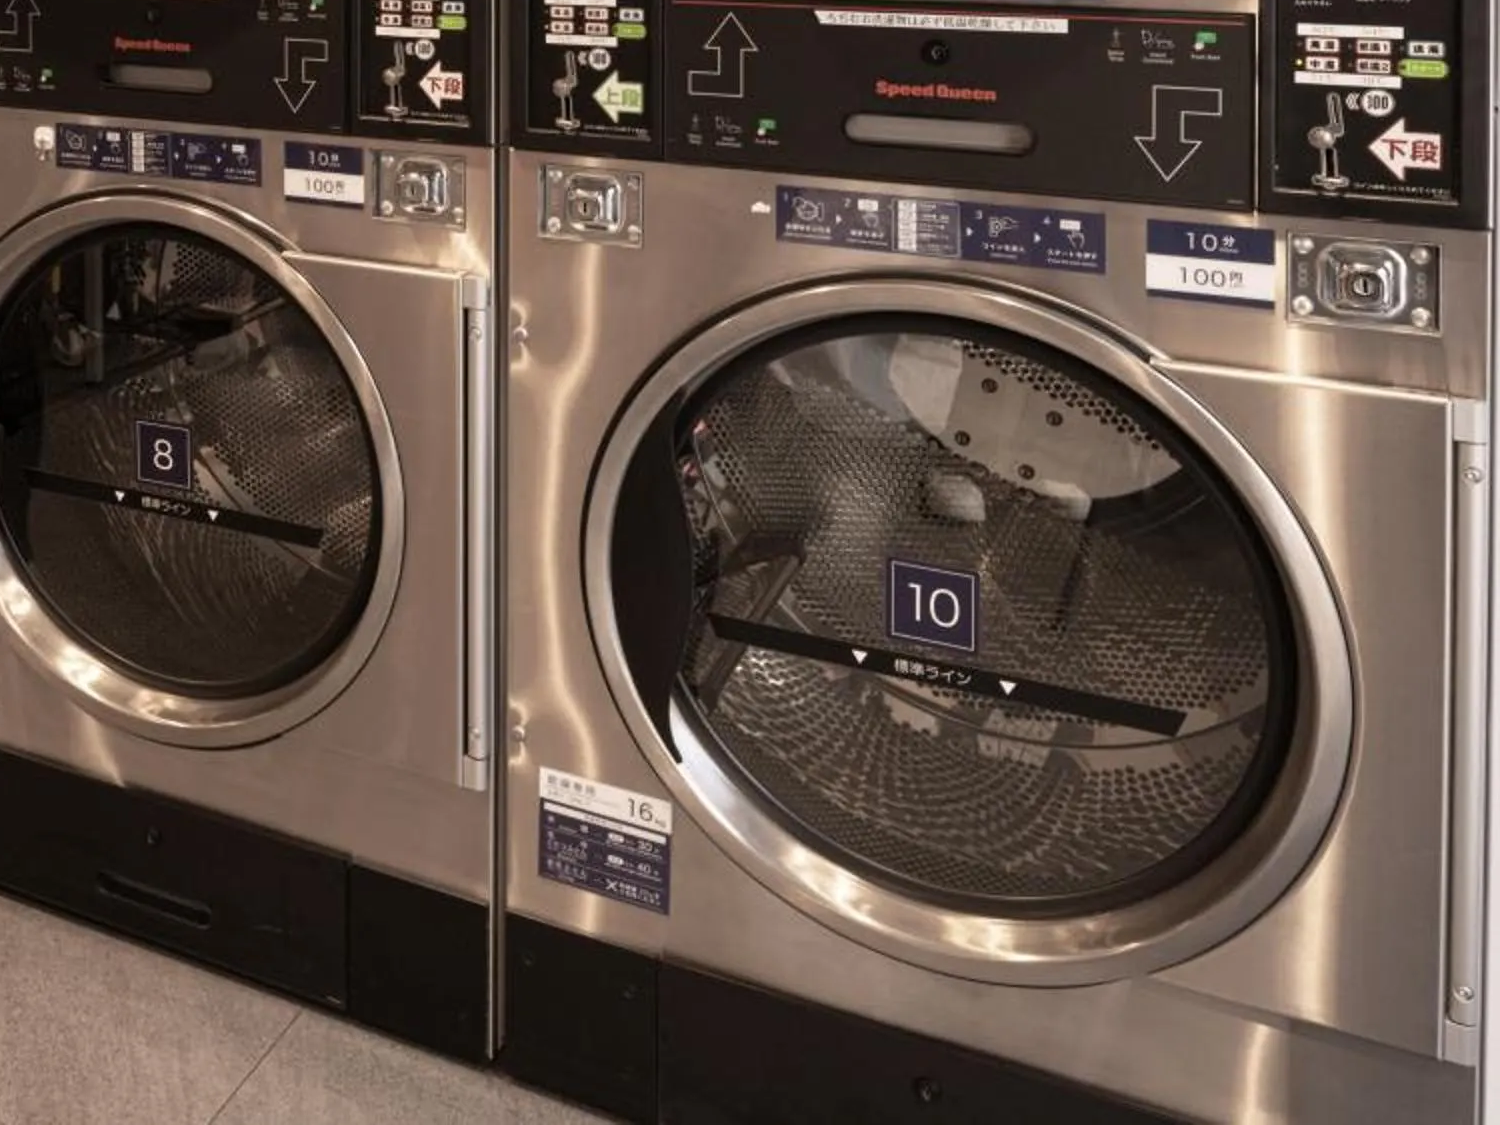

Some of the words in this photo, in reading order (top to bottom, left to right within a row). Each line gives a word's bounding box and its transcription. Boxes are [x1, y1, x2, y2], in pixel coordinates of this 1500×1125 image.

[426, 77, 462, 96] 下段
[875, 79, 934, 98] Speed
[936, 82, 998, 102] Queen
[1380, 136, 1440, 164] 下段
[1186, 231, 1236, 254] 10分
[1180, 266, 1244, 289] 100円
[153, 437, 174, 471] 8
[907, 582, 961, 629] 10
[894, 657, 973, 686] 標準ライン
